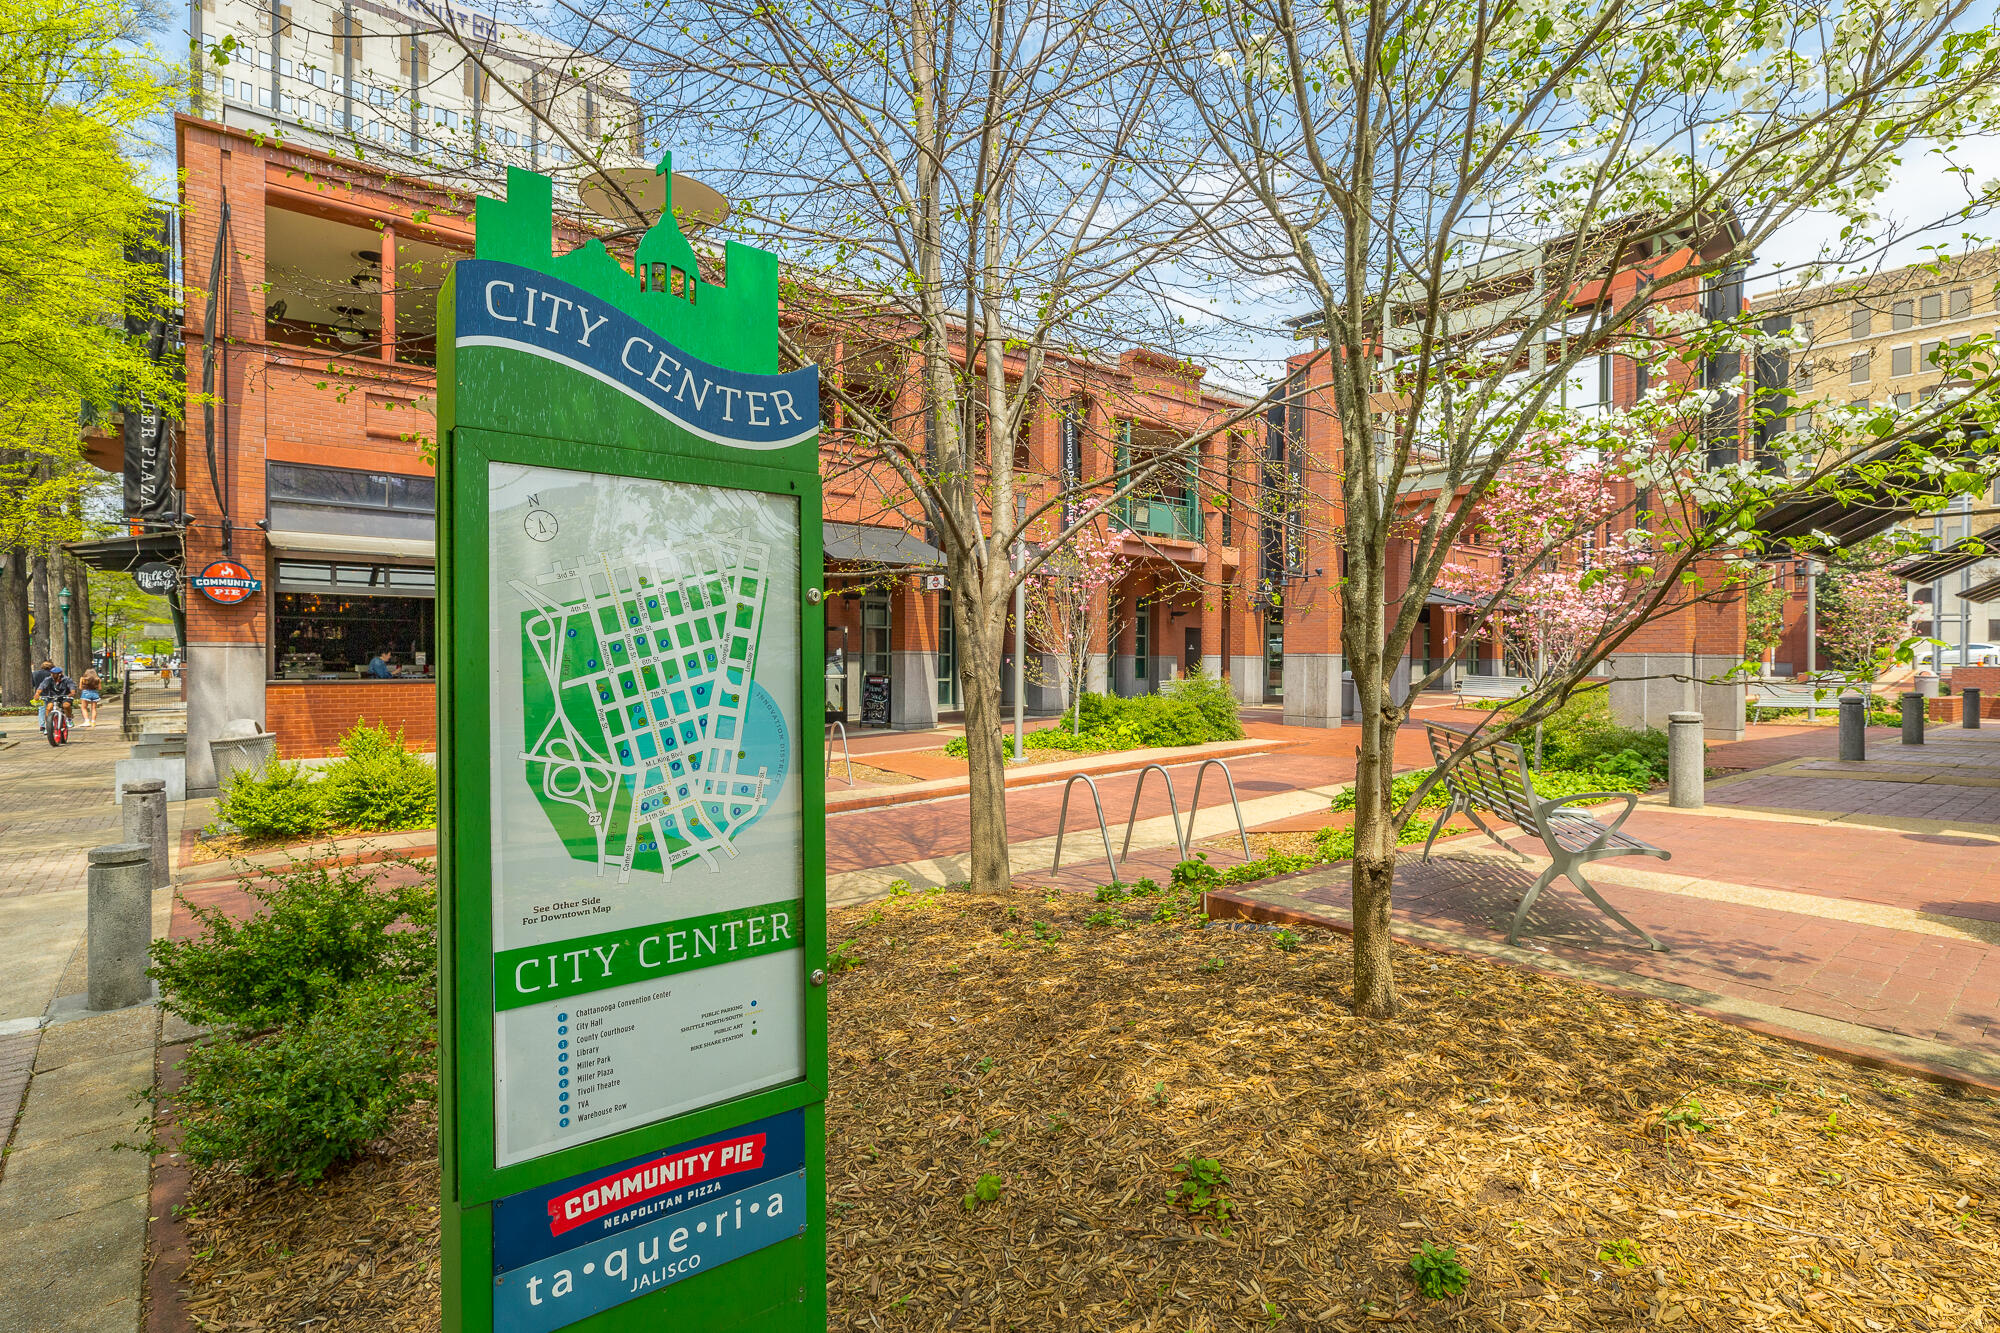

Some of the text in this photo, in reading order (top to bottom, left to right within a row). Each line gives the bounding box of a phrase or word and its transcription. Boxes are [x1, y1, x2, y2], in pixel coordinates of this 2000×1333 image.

[485, 280, 802, 426] CITY CENTER
[140, 446, 156, 508] PLAZA
[526, 493, 540, 507] N
[138, 570, 162, 581] Milk
[195, 578, 258, 588] COMMUNITY
[142, 580, 174, 590] Honey
[214, 588, 241, 596] PIE
[570, 605, 582, 613] 4th
[634, 626, 645, 635] 5th
[625, 633, 635, 652] Broad
[600, 640, 612, 667] Chestnut
[720, 644, 729, 665] Georgia
[642, 657, 653, 666] 6th
[650, 690, 661, 698] 7th
[659, 720, 670, 729] 8th
[756, 691, 786, 785] INNOVATION DISTRICT
[644, 787, 657, 797] 10th
[590, 815, 601, 824] 27
[645, 812, 659, 822] 11th
[623, 853, 631, 872] Carter
[668, 853, 682, 863] 12th
[533, 897, 601, 914] See Other Side
[522, 905, 611, 926] For Downtown Map
[515, 912, 791, 994] CITY CENTER
[576, 1003, 616, 1018] Chattanooga
[617, 995, 652, 1008] Convention
[652, 990, 672, 1000] Center
[701, 1004, 743, 1019] PUBLIC PARKING
[576, 1021, 589, 1031] City
[590, 1018, 603, 1028] Hall
[680, 1013, 744, 1032] SHUTTLE NORTH/SOUTH
[576, 1033, 599, 1044] County
[600, 1024, 635, 1038] Courthouse
[713, 1026, 732, 1035] PUBLIC
[690, 1033, 744, 1052] BIKE SHARE STATION
[576, 1046, 600, 1057] Library
[577, 1060, 595, 1070] Miller
[597, 1055, 611, 1065] Park
[577, 1073, 595, 1083] Miller
[597, 1068, 614, 1078] Plaza
[577, 1085, 595, 1096] Tivoli
[597, 1079, 621, 1091] Theatre
[578, 1100, 589, 1109] TVA
[578, 1107, 613, 1122] Warehouse
[614, 1103, 628, 1111] Row
[565, 1142, 754, 1220] COMMUNITY PIE
[604, 1181, 722, 1229] NEAPOLITAN PIZZA
[631, 1254, 700, 1293] JALISCO
